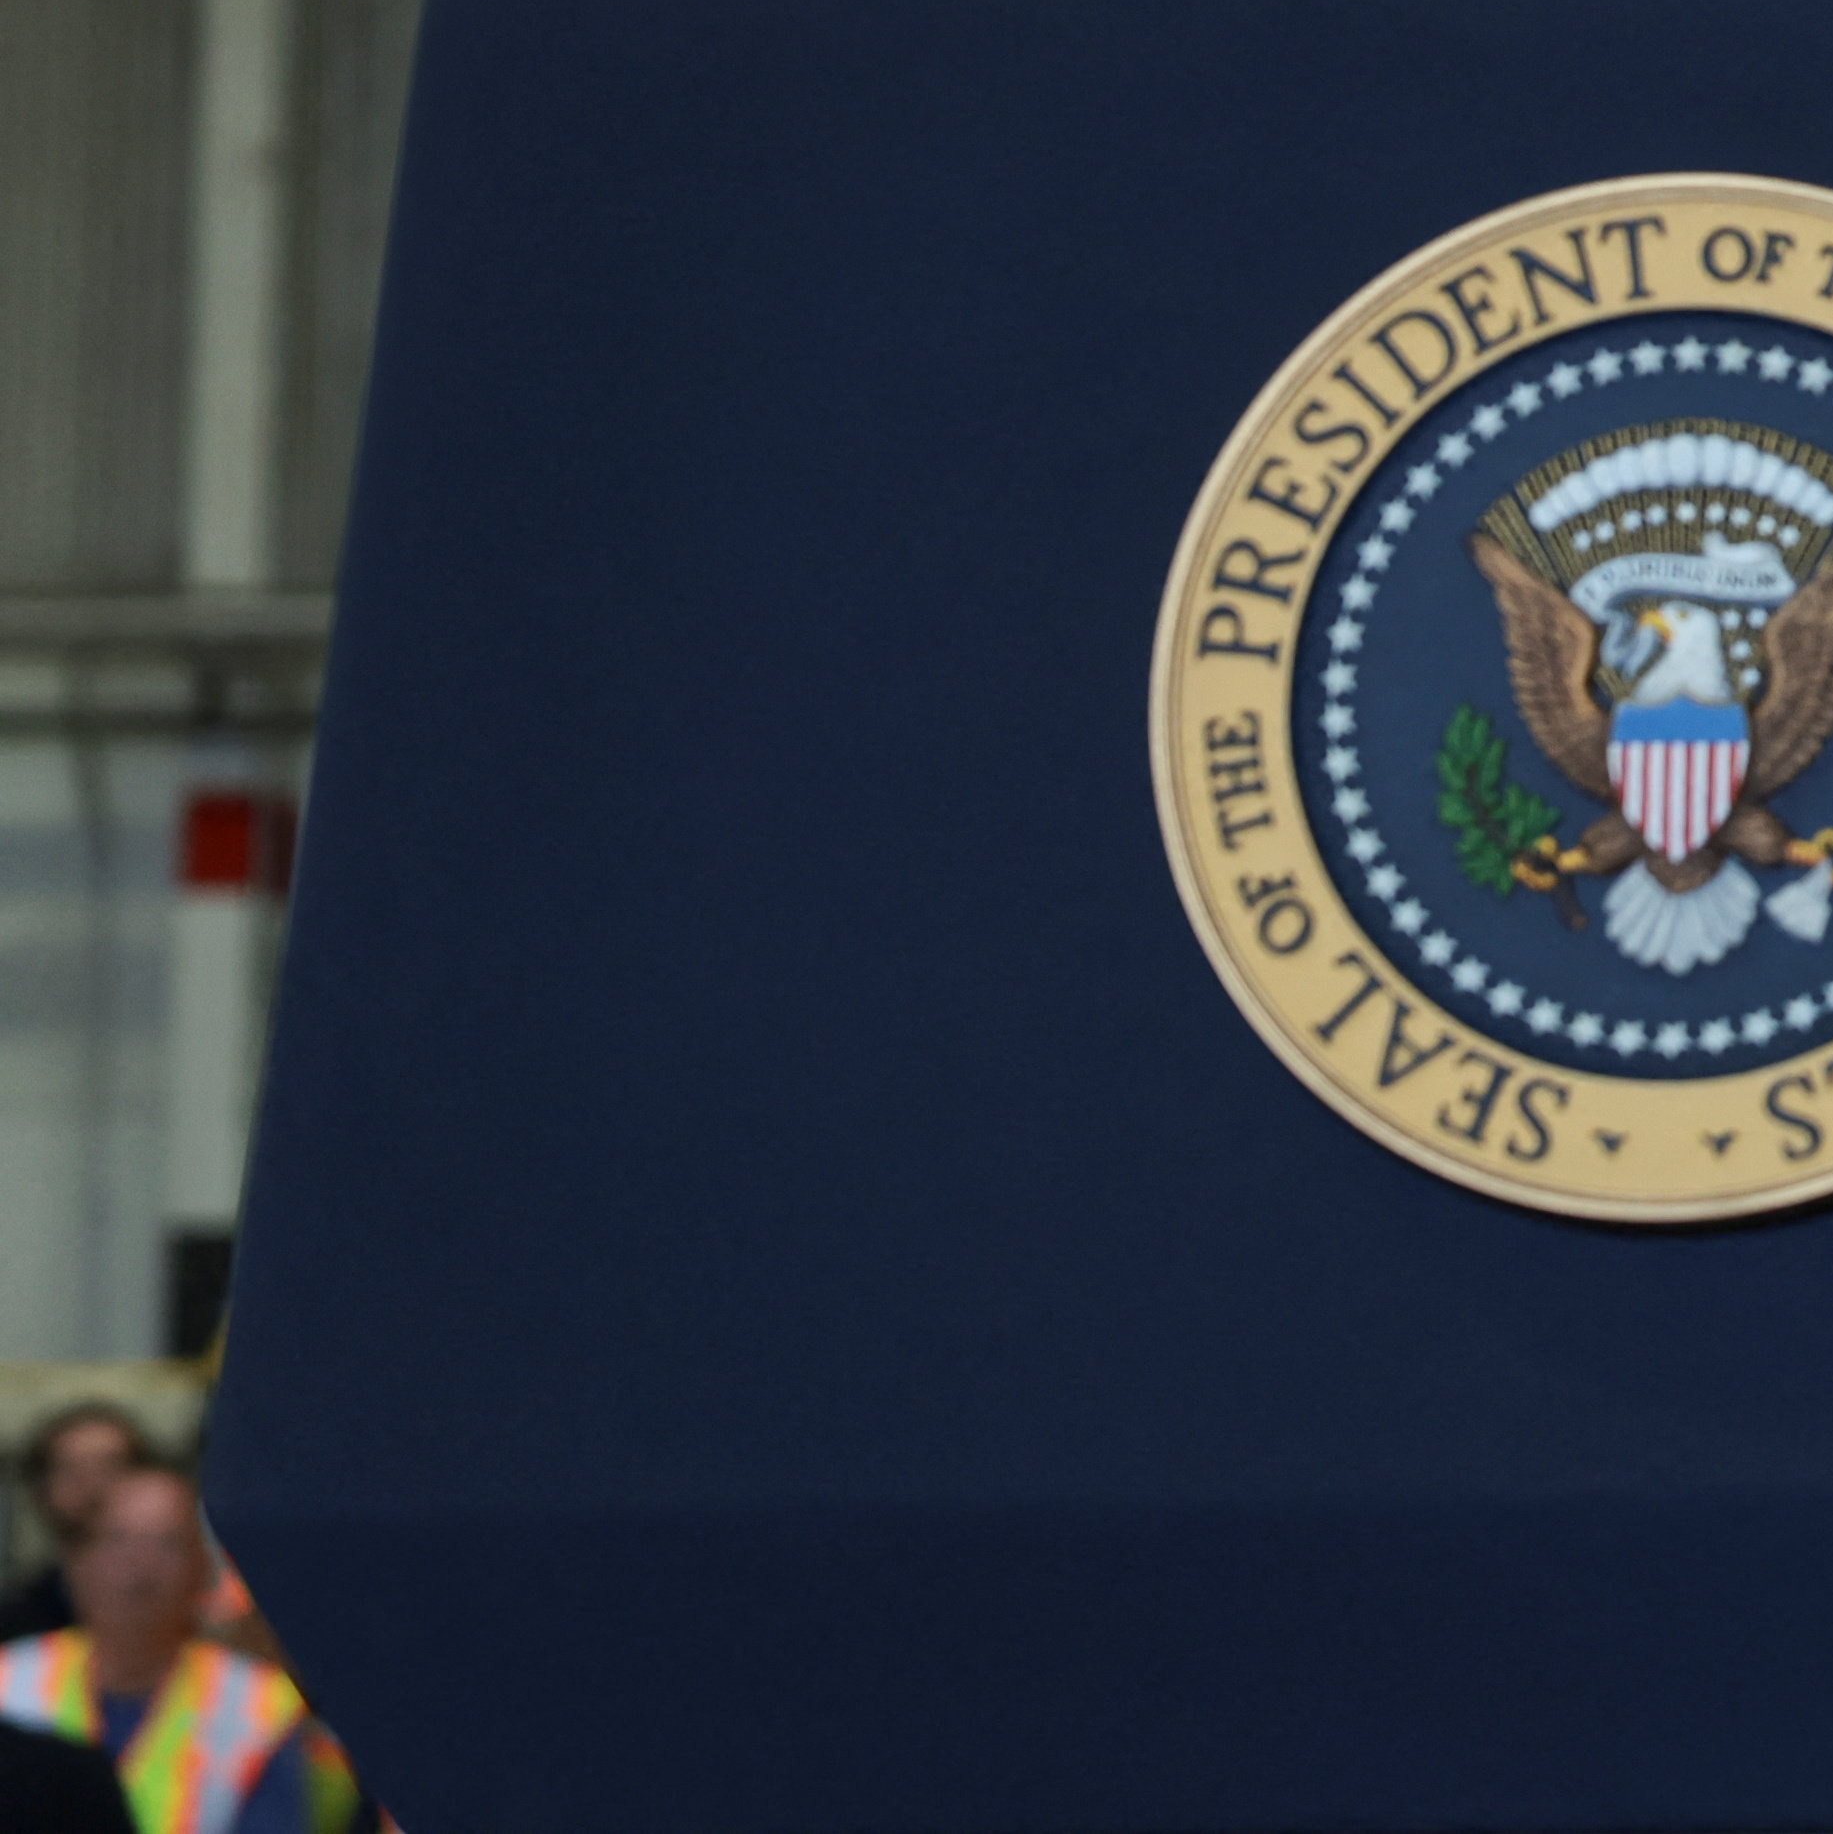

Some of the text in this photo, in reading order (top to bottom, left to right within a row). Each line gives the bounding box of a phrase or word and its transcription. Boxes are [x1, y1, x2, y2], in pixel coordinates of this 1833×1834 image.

[1701, 225, 1796, 284] OF
[1193, 216, 1669, 665] PRESIDENT
[1205, 709, 1277, 850] THE
[1236, 872, 1313, 958] OF
[1311, 955, 1572, 1164] SEAL
